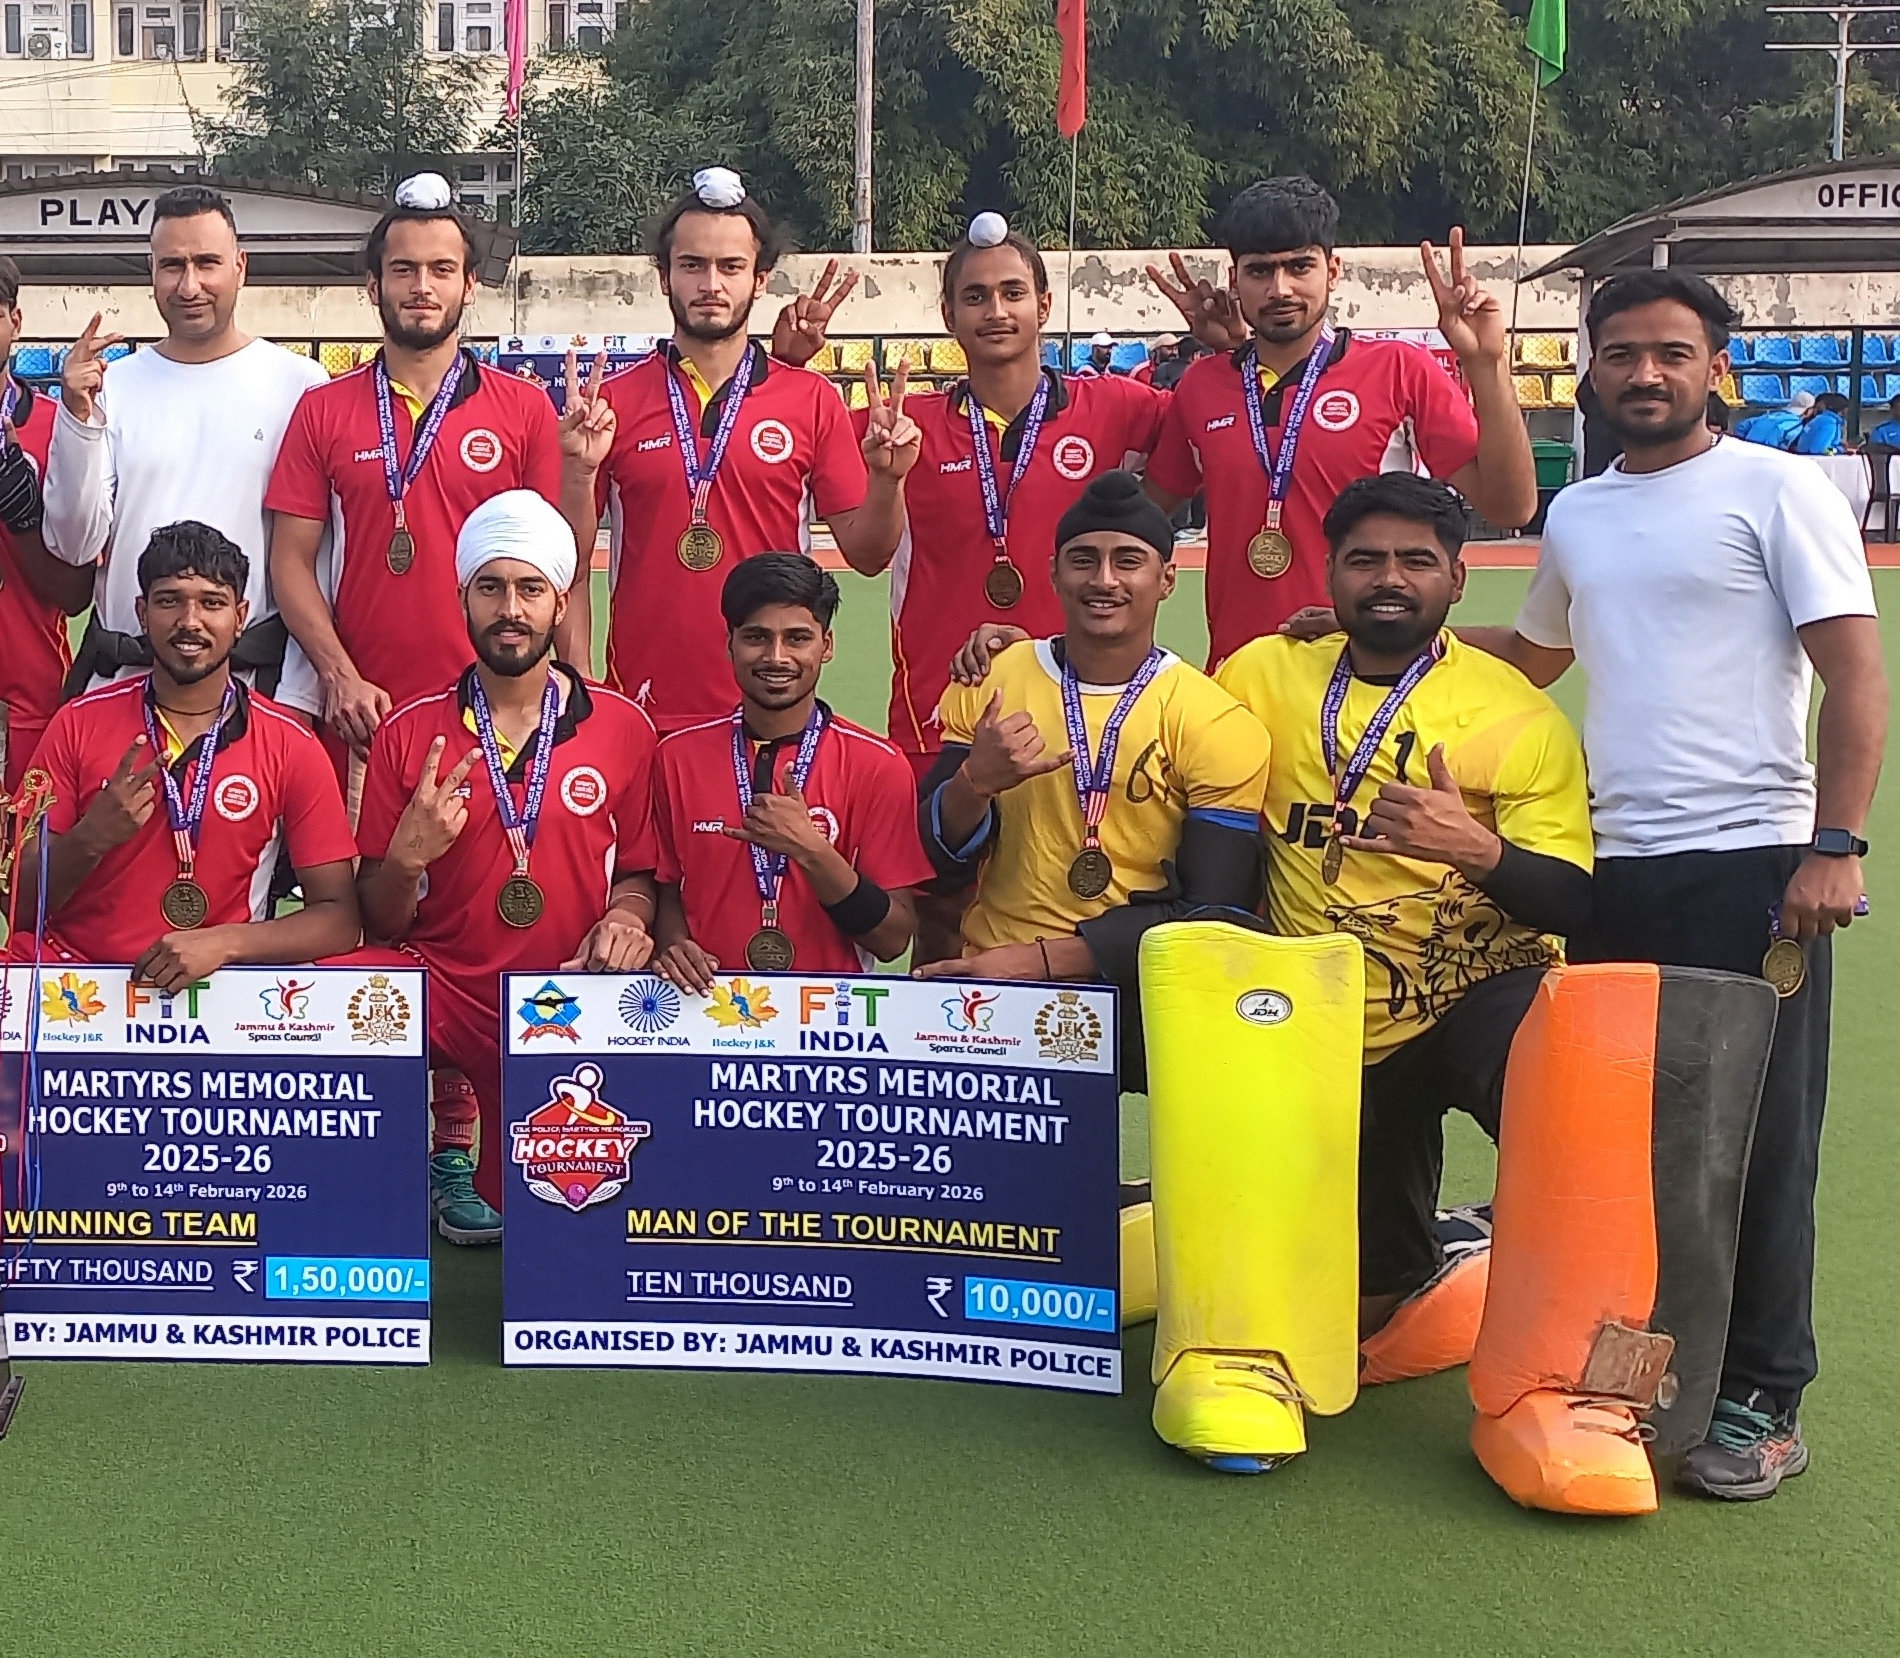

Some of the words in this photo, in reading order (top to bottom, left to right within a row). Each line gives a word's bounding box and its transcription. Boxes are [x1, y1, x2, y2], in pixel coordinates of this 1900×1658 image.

[1207, 414, 1236, 431] HMR
[638, 434, 671, 452] HMR
[940, 459, 976, 474] HMR
[1394, 730, 1416, 785] 1
[43, 1033, 80, 1043] Hockey
[84, 1033, 103, 1042] J&K
[126, 1024, 211, 1044] INDIA
[234, 1022, 275, 1032] Jammu
[278, 1023, 287, 1032] &
[289, 1022, 336, 1032] Kashmir
[248, 1033, 282, 1042] Sports
[284, 1033, 321, 1042] Council
[608, 1036, 654, 1046] HOCKEY
[657, 1036, 690, 1046] INDIA
[712, 1038, 752, 1048] Hockey
[754, 1038, 776, 1049] J&K
[800, 1031, 889, 1053] INDIA
[914, 1032, 957, 1043] Jammu
[960, 1034, 970, 1043] &
[972, 1035, 1021, 1047] Kashmir
[929, 1042, 964, 1054] Sports
[966, 1044, 1007, 1056] Council
[43, 1070, 192, 1099] MARTYRS
[203, 1072, 374, 1101] MEMORIAL
[711, 1063, 869, 1094] MARTYRS
[878, 1069, 1061, 1107] MEMORIAL
[28, 1107, 152, 1136] HOCKEY
[161, 1107, 382, 1138] TOURNAMENT
[694, 1100, 826, 1131] HOCKEY
[835, 1104, 1070, 1145] TOURNAMENT
[143, 1144, 272, 1173] 2025-26
[517, 1138, 632, 1158] HOCKEY
[817, 1140, 953, 1174] 2025-26
[529, 1161, 623, 1175] TOURNAMENT
[107, 1183, 128, 1197] 9th
[132, 1184, 149, 1197] to
[153, 1183, 184, 1197] 14th
[189, 1184, 261, 1201] February
[266, 1185, 307, 1199] 2026
[772, 1176, 794, 1191] 9th
[798, 1178, 816, 1192] to
[821, 1178, 853, 1193] 14th
[858, 1180, 935, 1201] February
[940, 1184, 984, 1201] 2026
[5, 1211, 152, 1237] WINNING
[162, 1212, 256, 1238] TEAM
[627, 1209, 696, 1235] MAN
[706, 1211, 749, 1237] OF
[758, 1212, 822, 1239] THE
[832, 1213, 1061, 1254] TOURNAMENT
[68, 1259, 213, 1284] THOUSAND
[274, 1265, 425, 1294] 1,50,000/-
[627, 1271, 683, 1295] TEN
[691, 1272, 853, 1299] THOUSAND
[969, 1282, 1110, 1322] 10,000/-
[14, 1323, 55, 1344] BY:
[63, 1323, 160, 1346] JAMMU
[167, 1325, 186, 1346] &
[194, 1324, 318, 1348] KASHMIR
[326, 1327, 421, 1349] POLICE
[514, 1329, 675, 1353] ORGANISED
[683, 1332, 727, 1355] BY:
[735, 1334, 833, 1358] JAMMU
[842, 1337, 861, 1358] &
[871, 1339, 1001, 1368] KASHMIR
[1010, 1349, 1112, 1378] POLICE
